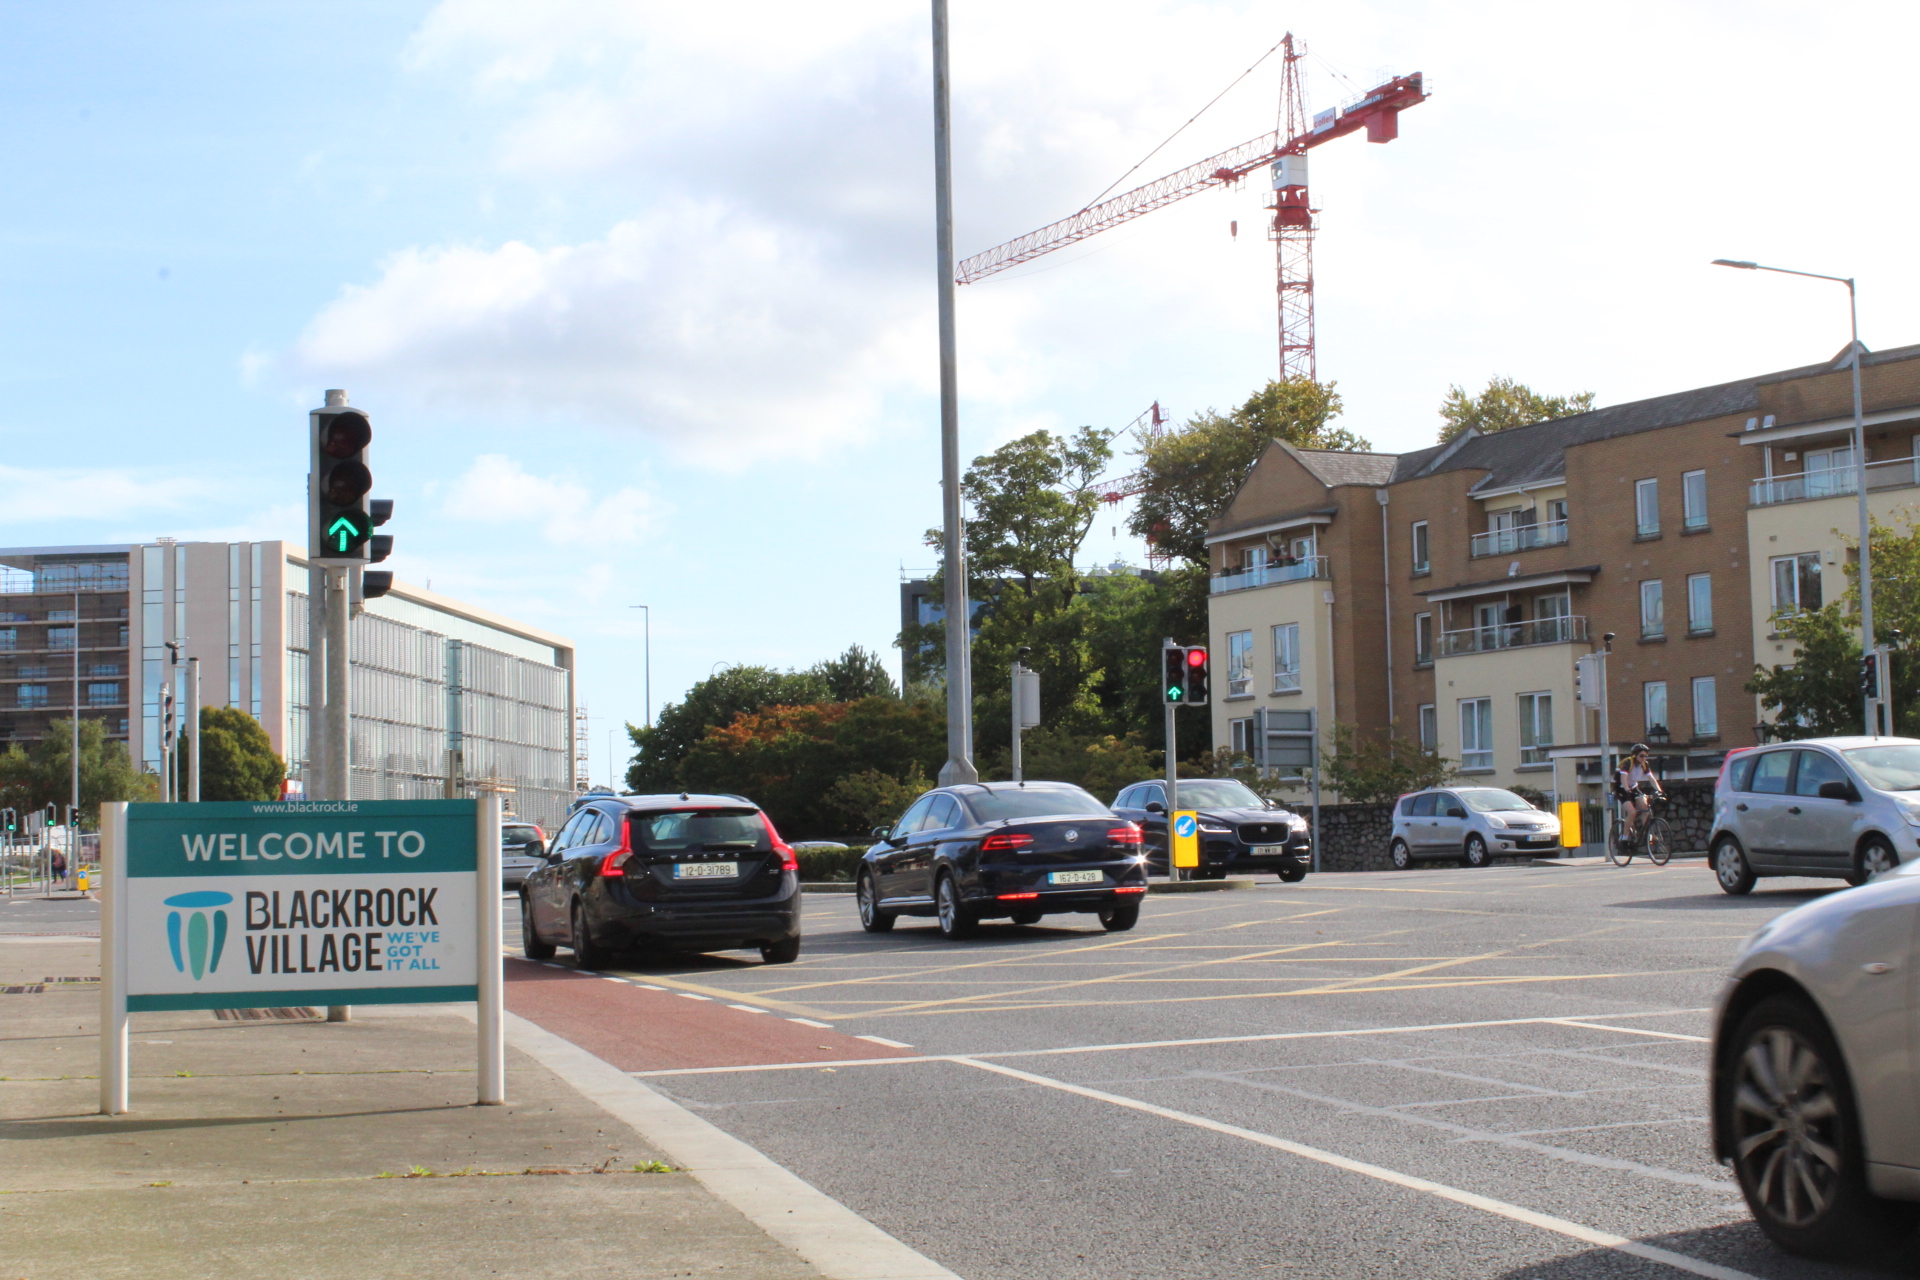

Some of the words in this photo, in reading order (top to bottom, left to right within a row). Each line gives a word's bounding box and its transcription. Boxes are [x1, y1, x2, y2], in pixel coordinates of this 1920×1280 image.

[1313, 114, 1334, 128] collen
[253, 801, 358, 813] www.blackrock.ie
[181, 831, 366, 862] WELCOME
[375, 830, 426, 858] TO
[685, 864, 731, 876] 12-D-31789
[1059, 872, 1096, 883] 162-D-428
[246, 887, 439, 931] BLACKROCK
[386, 931, 440, 944] WE'VE
[246, 932, 383, 975] VILLAGE
[386, 945, 424, 957] GOT
[387, 959, 404, 971] IT
[409, 958, 440, 970] ALL
